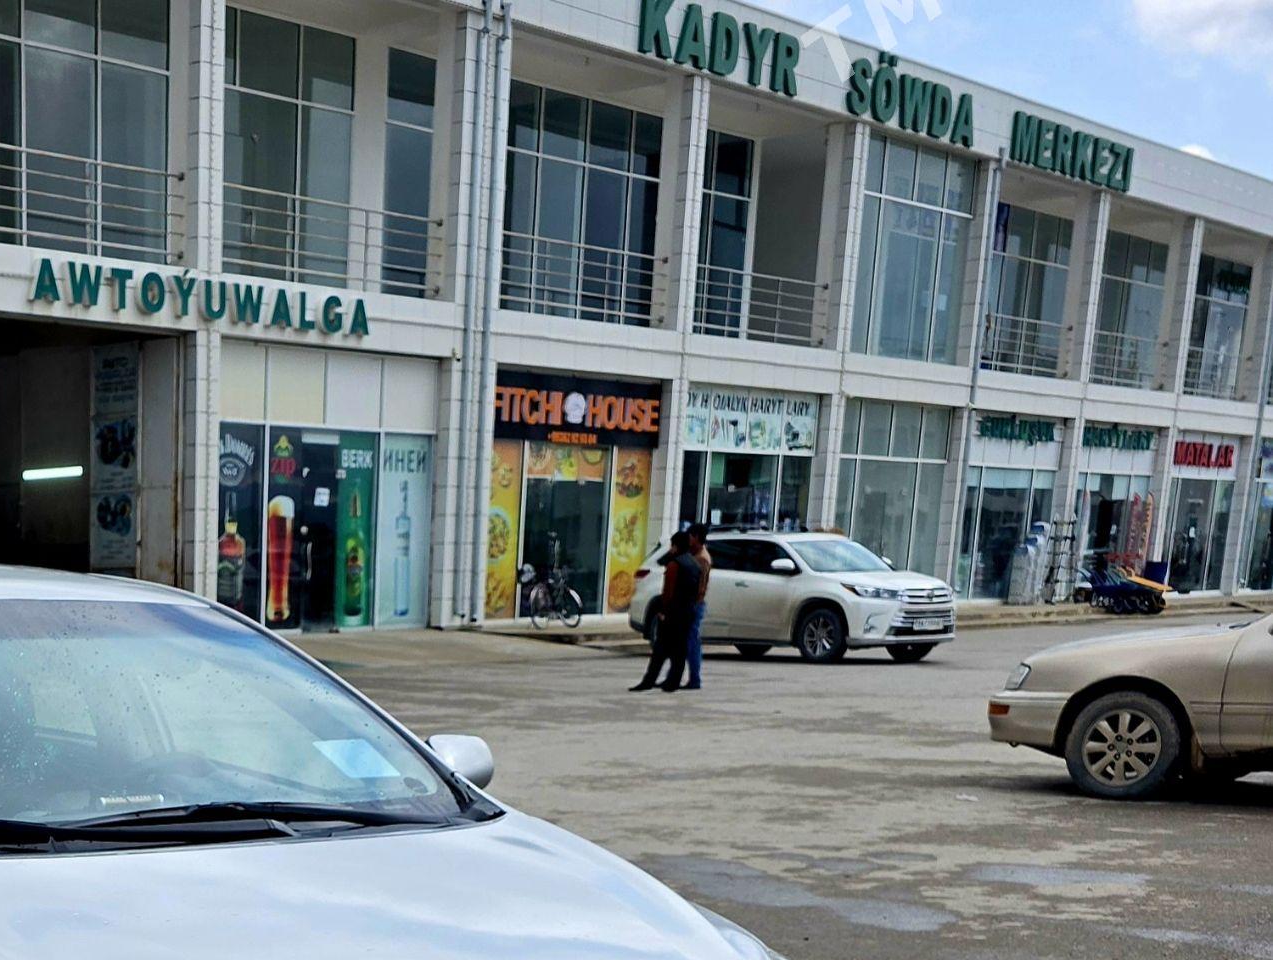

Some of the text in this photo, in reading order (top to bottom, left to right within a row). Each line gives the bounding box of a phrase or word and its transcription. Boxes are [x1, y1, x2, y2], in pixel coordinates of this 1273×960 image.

[637, 0, 1133, 192] KADYR SÖWDA MERKEZI
[30, 256, 371, 337] AWTOÝUWALGA
[585, 394, 660, 432] HOUSE
